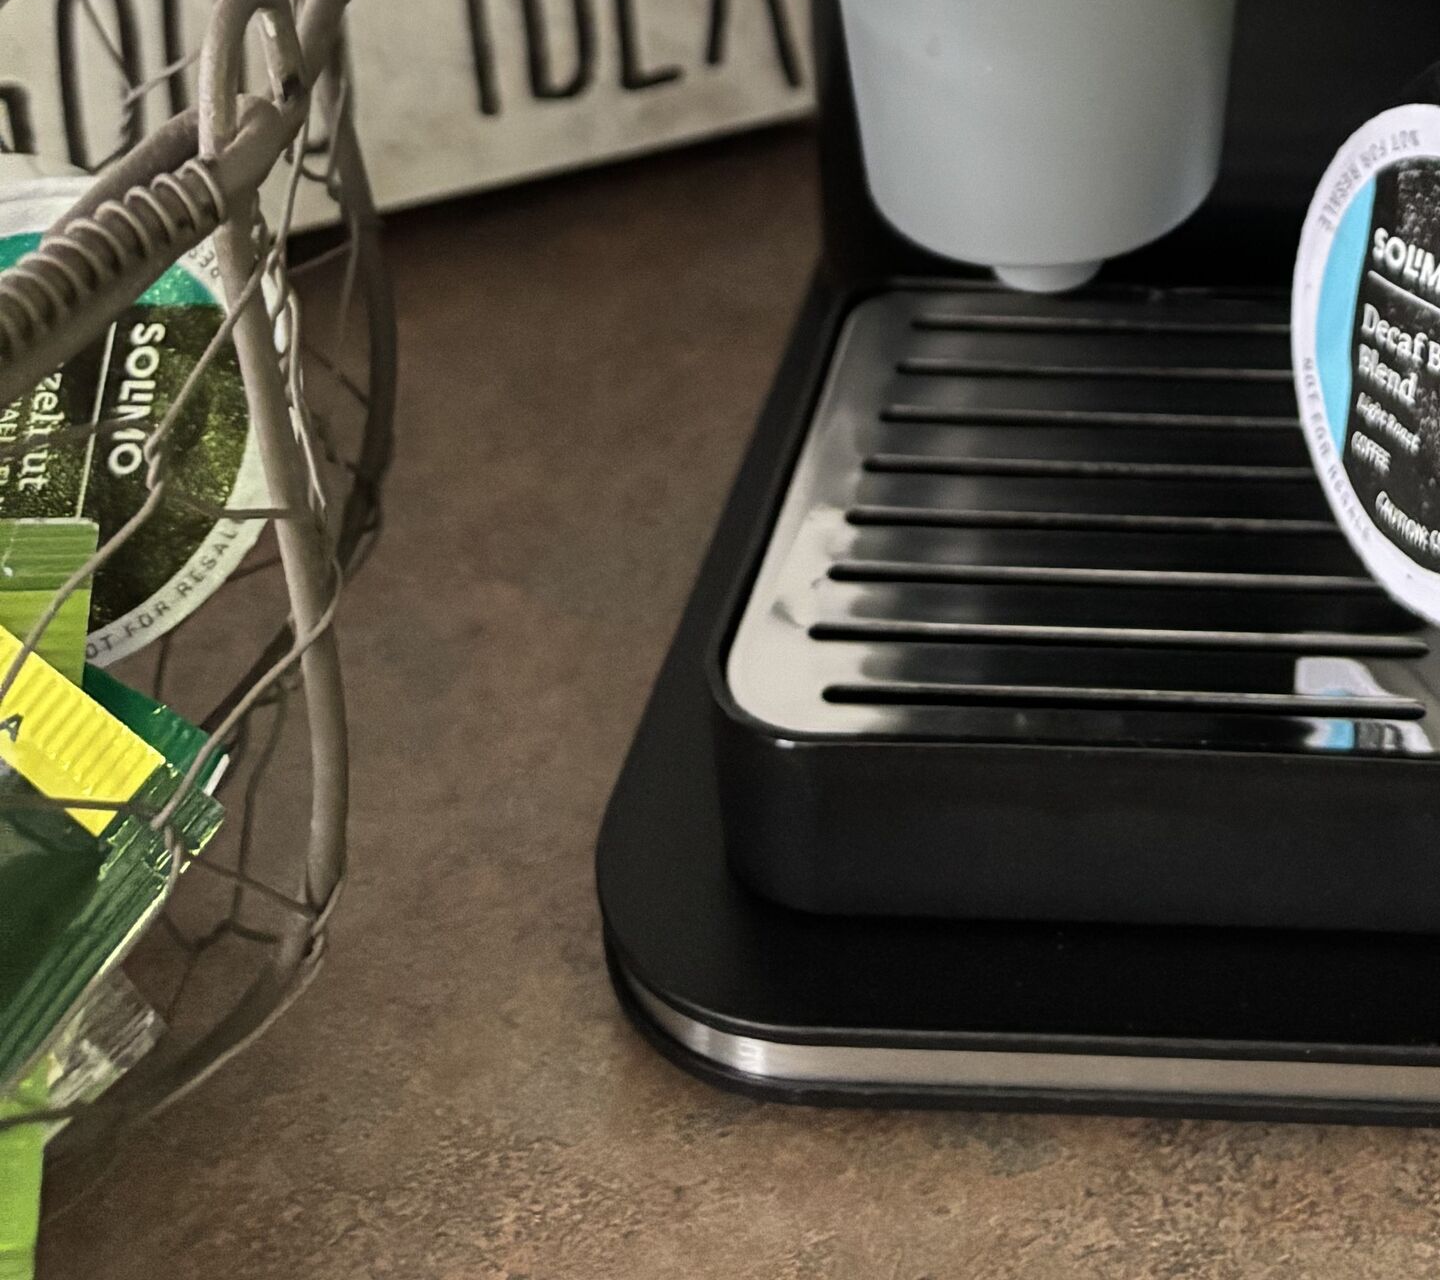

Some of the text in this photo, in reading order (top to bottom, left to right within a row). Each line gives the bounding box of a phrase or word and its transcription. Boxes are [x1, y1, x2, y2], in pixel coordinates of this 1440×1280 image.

[1361, 302, 1429, 367] Decaf
[1358, 343, 1418, 407] Blend
[123, 601, 171, 638] FOR
[176, 518, 247, 599] RESAL
